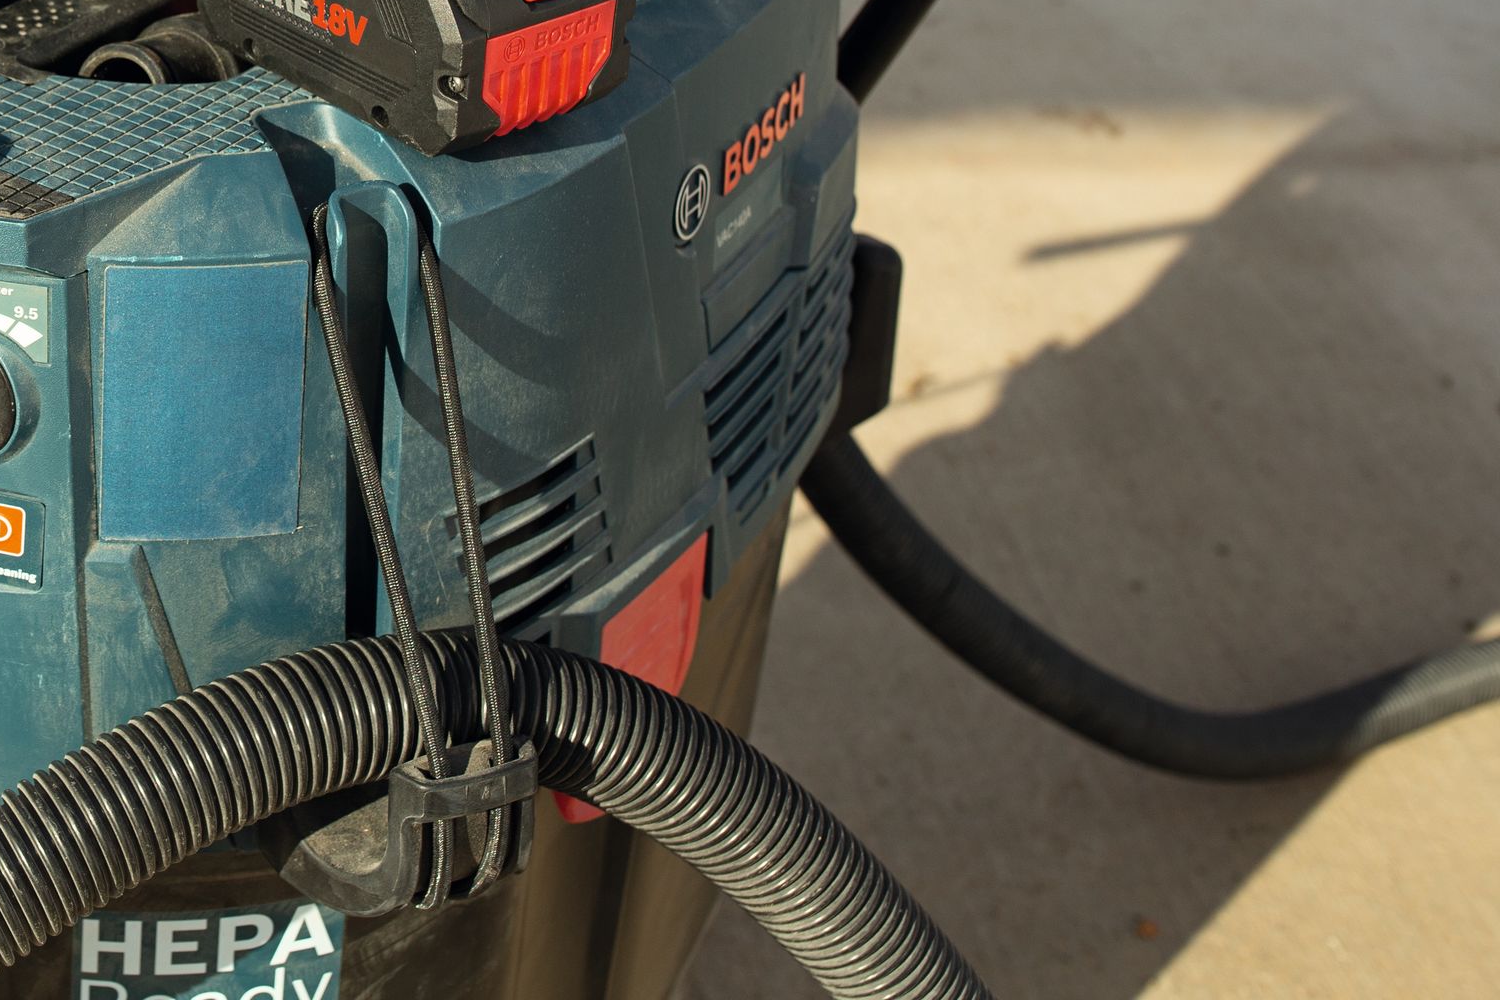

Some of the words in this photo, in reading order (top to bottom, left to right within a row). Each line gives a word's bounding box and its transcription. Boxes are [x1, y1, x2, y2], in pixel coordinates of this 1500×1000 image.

[533, 12, 600, 52] BOSCH
[723, 71, 806, 197] BOSCH
[13, 306, 39, 321] 9.5
[80, 903, 335, 976] HEPA
